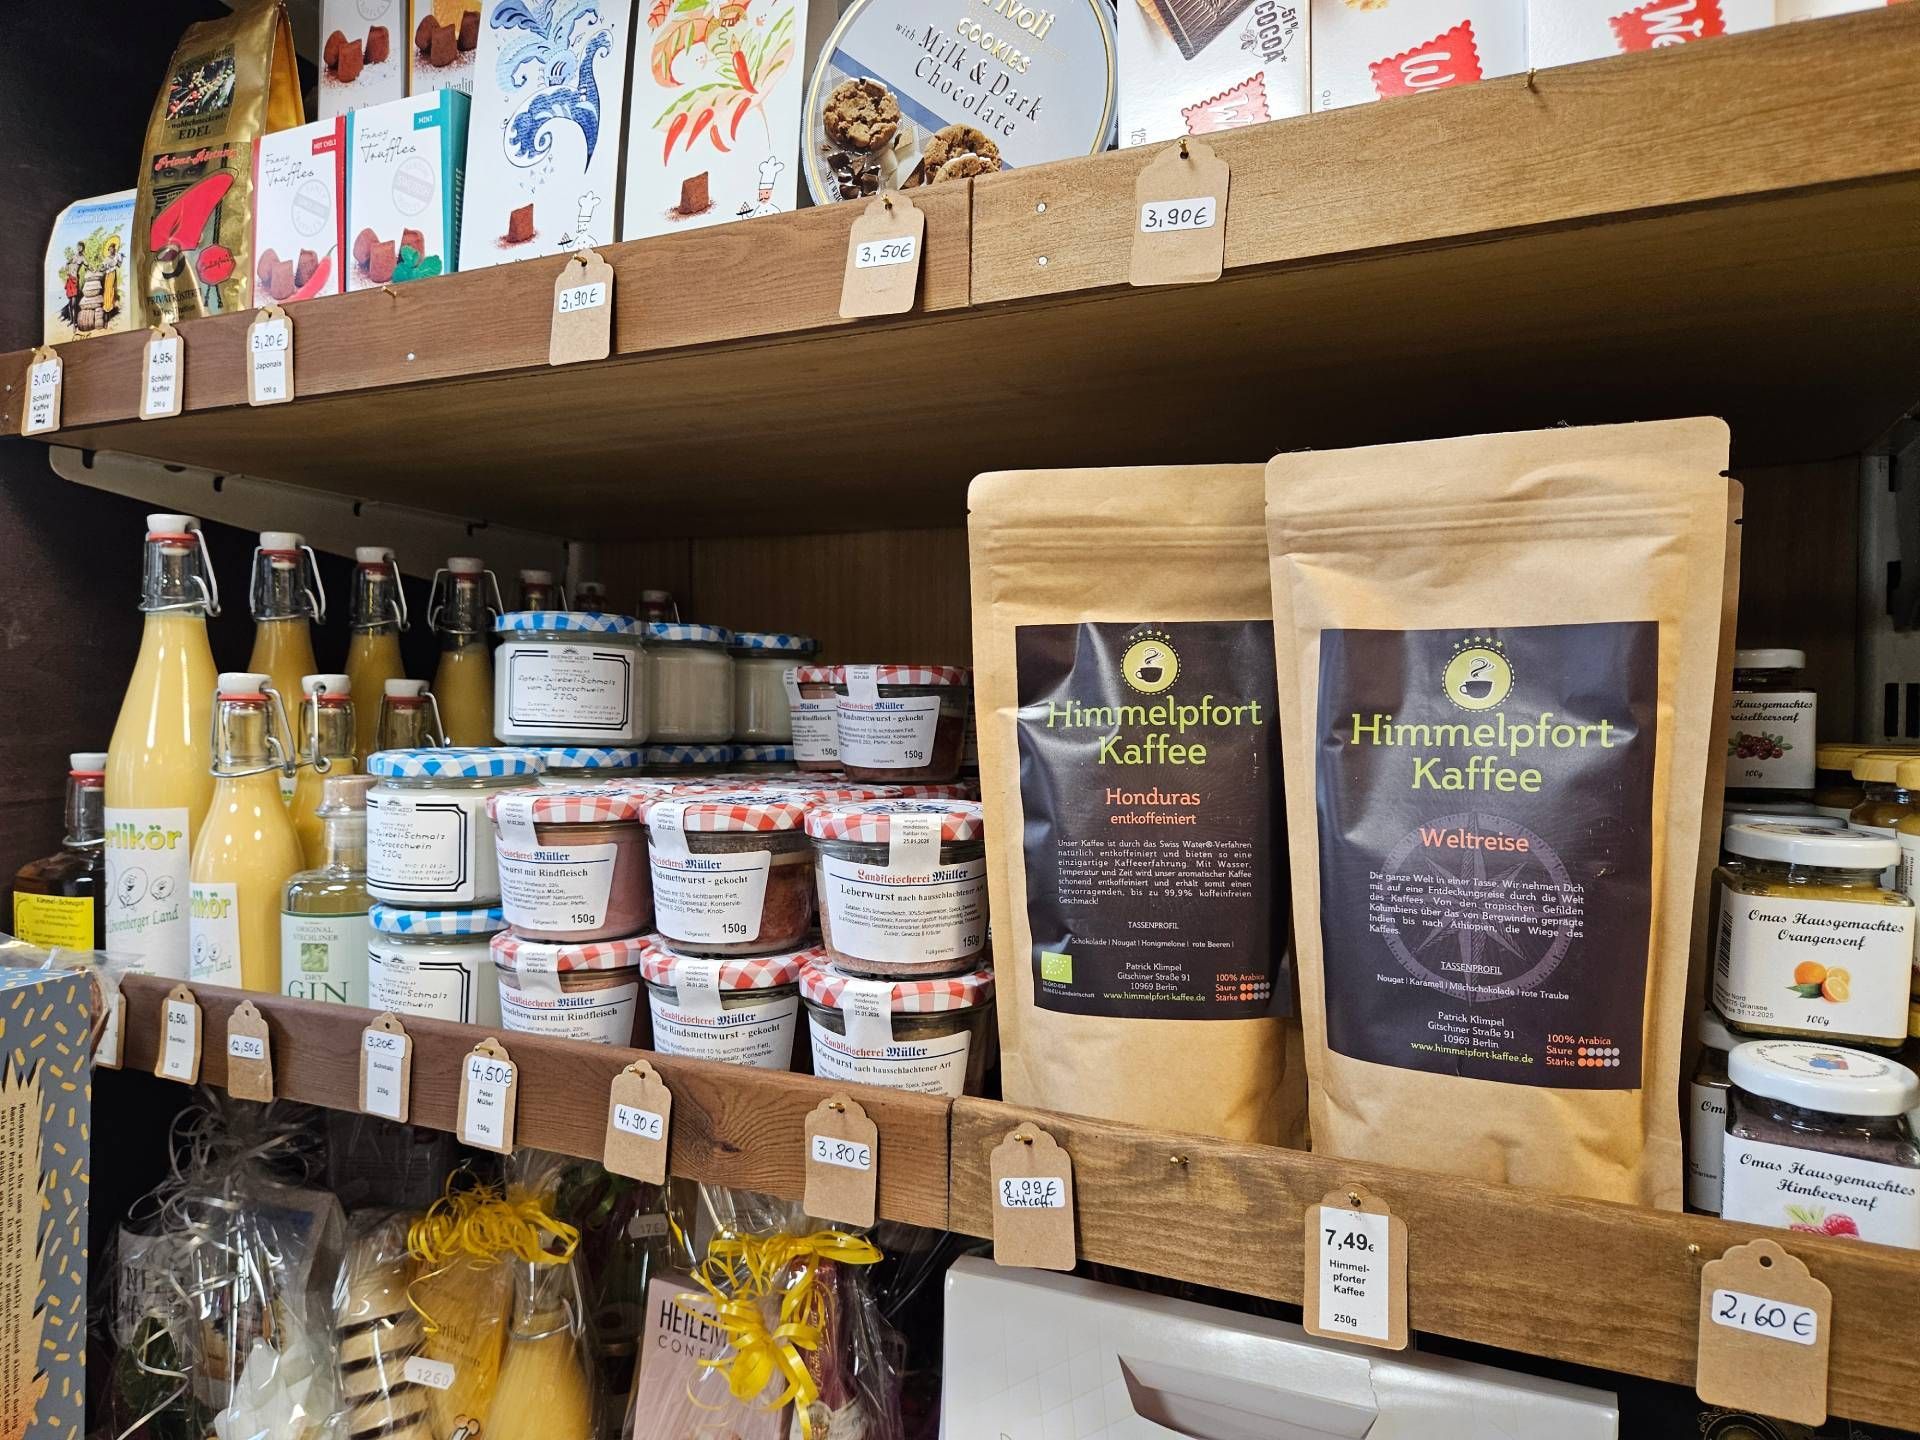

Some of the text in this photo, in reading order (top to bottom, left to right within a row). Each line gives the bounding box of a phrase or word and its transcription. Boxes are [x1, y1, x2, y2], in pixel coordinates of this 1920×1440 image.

[982, 0, 1056, 41] ivoli
[957, 17, 1032, 75] COOKIES
[895, 22, 1043, 121] with Milk & Dark
[915, 53, 1016, 137] Chocolate
[179, 125, 212, 140] EDEL
[360, 137, 416, 163] Truffles
[266, 161, 314, 186] Truffles
[1732, 700, 1813, 710] Hausgemachtes
[1047, 695, 1262, 733] Himmelpfort
[1730, 712, 1799, 723] reiselbeersenf
[1350, 712, 1614, 756] Himmelpfort
[904, 750, 923, 759] 150g
[1099, 734, 1207, 765] Kaffee
[1412, 756, 1542, 792] Kaffee
[1106, 787, 1201, 806] Honduras
[1111, 812, 1196, 825] entkoffeiniert
[1420, 828, 1529, 852] Weltreise
[534, 851, 570, 861] Müller
[685, 859, 721, 869] Müller
[539, 869, 587, 877] Rindfleisch
[932, 869, 968, 882] Müller
[714, 876, 748, 886] gekocht
[1370, 872, 1383, 880] Die
[1386, 873, 1410, 882] ganze
[1413, 875, 1434, 883] Welt
[1448, 877, 1470, 885] einer
[1473, 878, 1499, 888] Tasse.
[1503, 880, 1520, 889] Wir
[1523, 882, 1560, 892] nehmen
[1564, 884, 1584, 893] Dich
[841, 884, 895, 902] Leberwurst
[571, 914, 595, 924] 150g
[1128, 921, 1179, 929] TASSENPROFIL
[1748, 909, 1904, 933] Omas Hausgemachtes
[722, 923, 747, 934] 150g
[963, 935, 979, 948] 150g
[1777, 929, 1866, 950] Orangensenf
[1153, 963, 1182, 972] Klimpel
[1441, 961, 1502, 975] TASSENPROFIL
[1117, 972, 1153, 981] Gitschiner
[1155, 973, 1180, 981] Straße
[1216, 973, 1264, 982] 100% Arabica
[289, 980, 350, 1003] GIN
[1130, 982, 1177, 991] 10969 Berlin
[1377, 975, 1569, 1000] Nougat Karamell Milchschokolade rote Traube
[557, 997, 595, 1006] Müller
[567, 1008, 617, 1020] Rindfleisch
[717, 1013, 756, 1025] Müller
[1438, 1011, 1505, 1027] Patrick Klimpel
[1806, 1014, 1829, 1026] 100g
[669, 1024, 780, 1040] Rindsmettwurst gekocht
[1428, 1021, 1515, 1039] Gitschiner Straße 91
[1443, 1034, 1499, 1049] 10969 Berlin
[1547, 1034, 1611, 1045] 100% Arabica
[887, 1046, 927, 1057] Müller
[939, 1061, 951, 1070] Art
[479, 1089, 493, 1097] Peter
[477, 1098, 494, 1107] Müller
[18, 1103, 26, 1148] Moonshine
[1740, 1152, 1915, 1197] Omas Hausgemachtes
[1776, 1179, 1878, 1212] Himbeersenf
[1329, 1259, 1370, 1272] Himmel-
[1333, 1273, 1366, 1284] pforter
[1334, 1284, 1365, 1296] Kaffee
[1334, 1313, 1357, 1327] 250g
